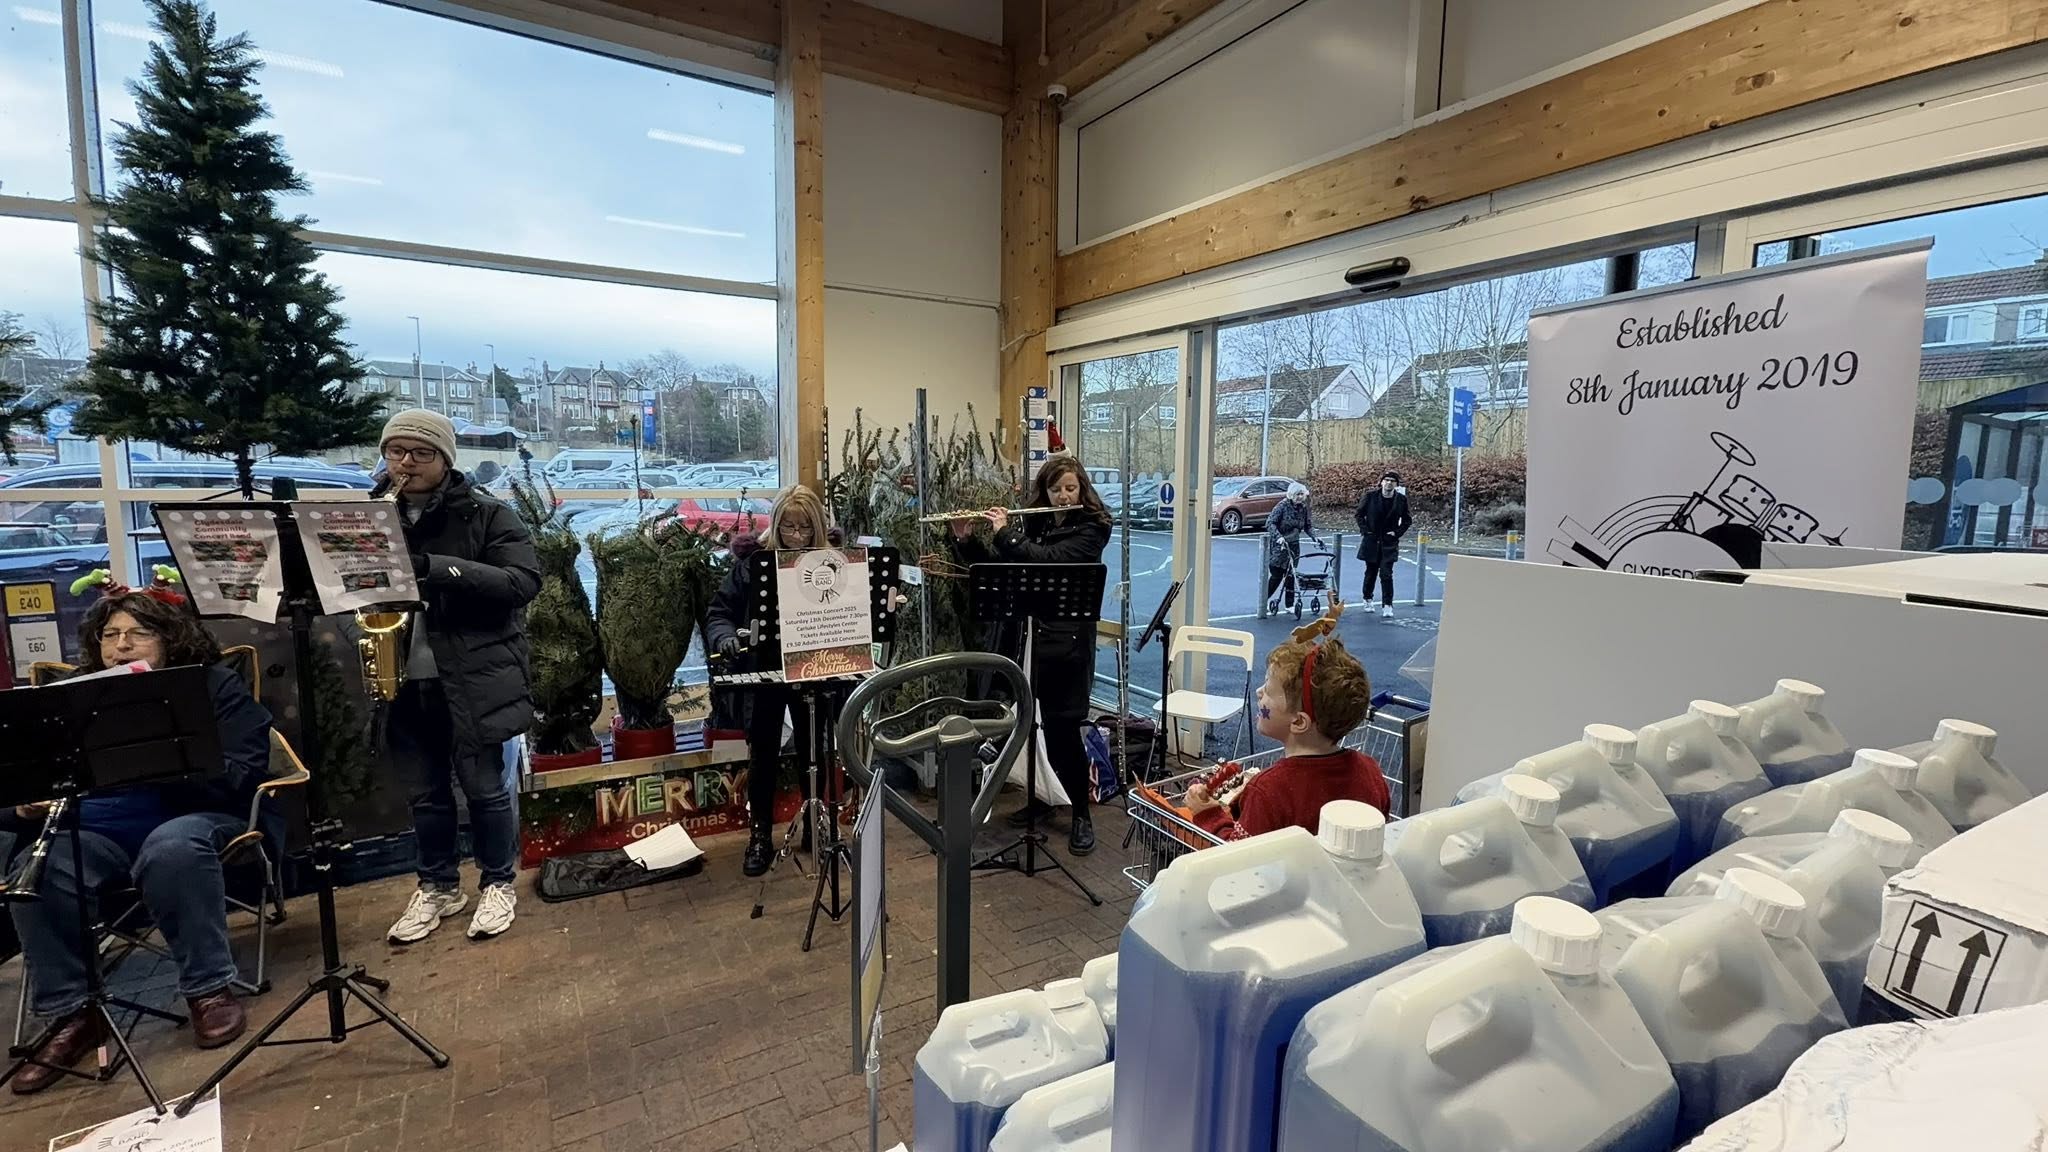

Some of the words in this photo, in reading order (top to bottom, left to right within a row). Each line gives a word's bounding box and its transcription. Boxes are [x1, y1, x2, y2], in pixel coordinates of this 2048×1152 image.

[1615, 294, 1789, 350] Established
[1566, 373, 1613, 406] 8th
[1618, 368, 1748, 417] January
[1757, 350, 1860, 392] 2019
[1623, 563, 1696, 580] CLYDESD
[19, 596, 41, 610] £40
[785, 617, 809, 625] Saturday
[796, 609, 822, 617] Christmas
[839, 634, 870, 642] Concessions
[28, 642, 46, 653] £60
[811, 649, 850, 665] Merry
[801, 661, 861, 679] Christmas
[594, 768, 749, 829] MERRY
[631, 811, 728, 839] Chritmas
